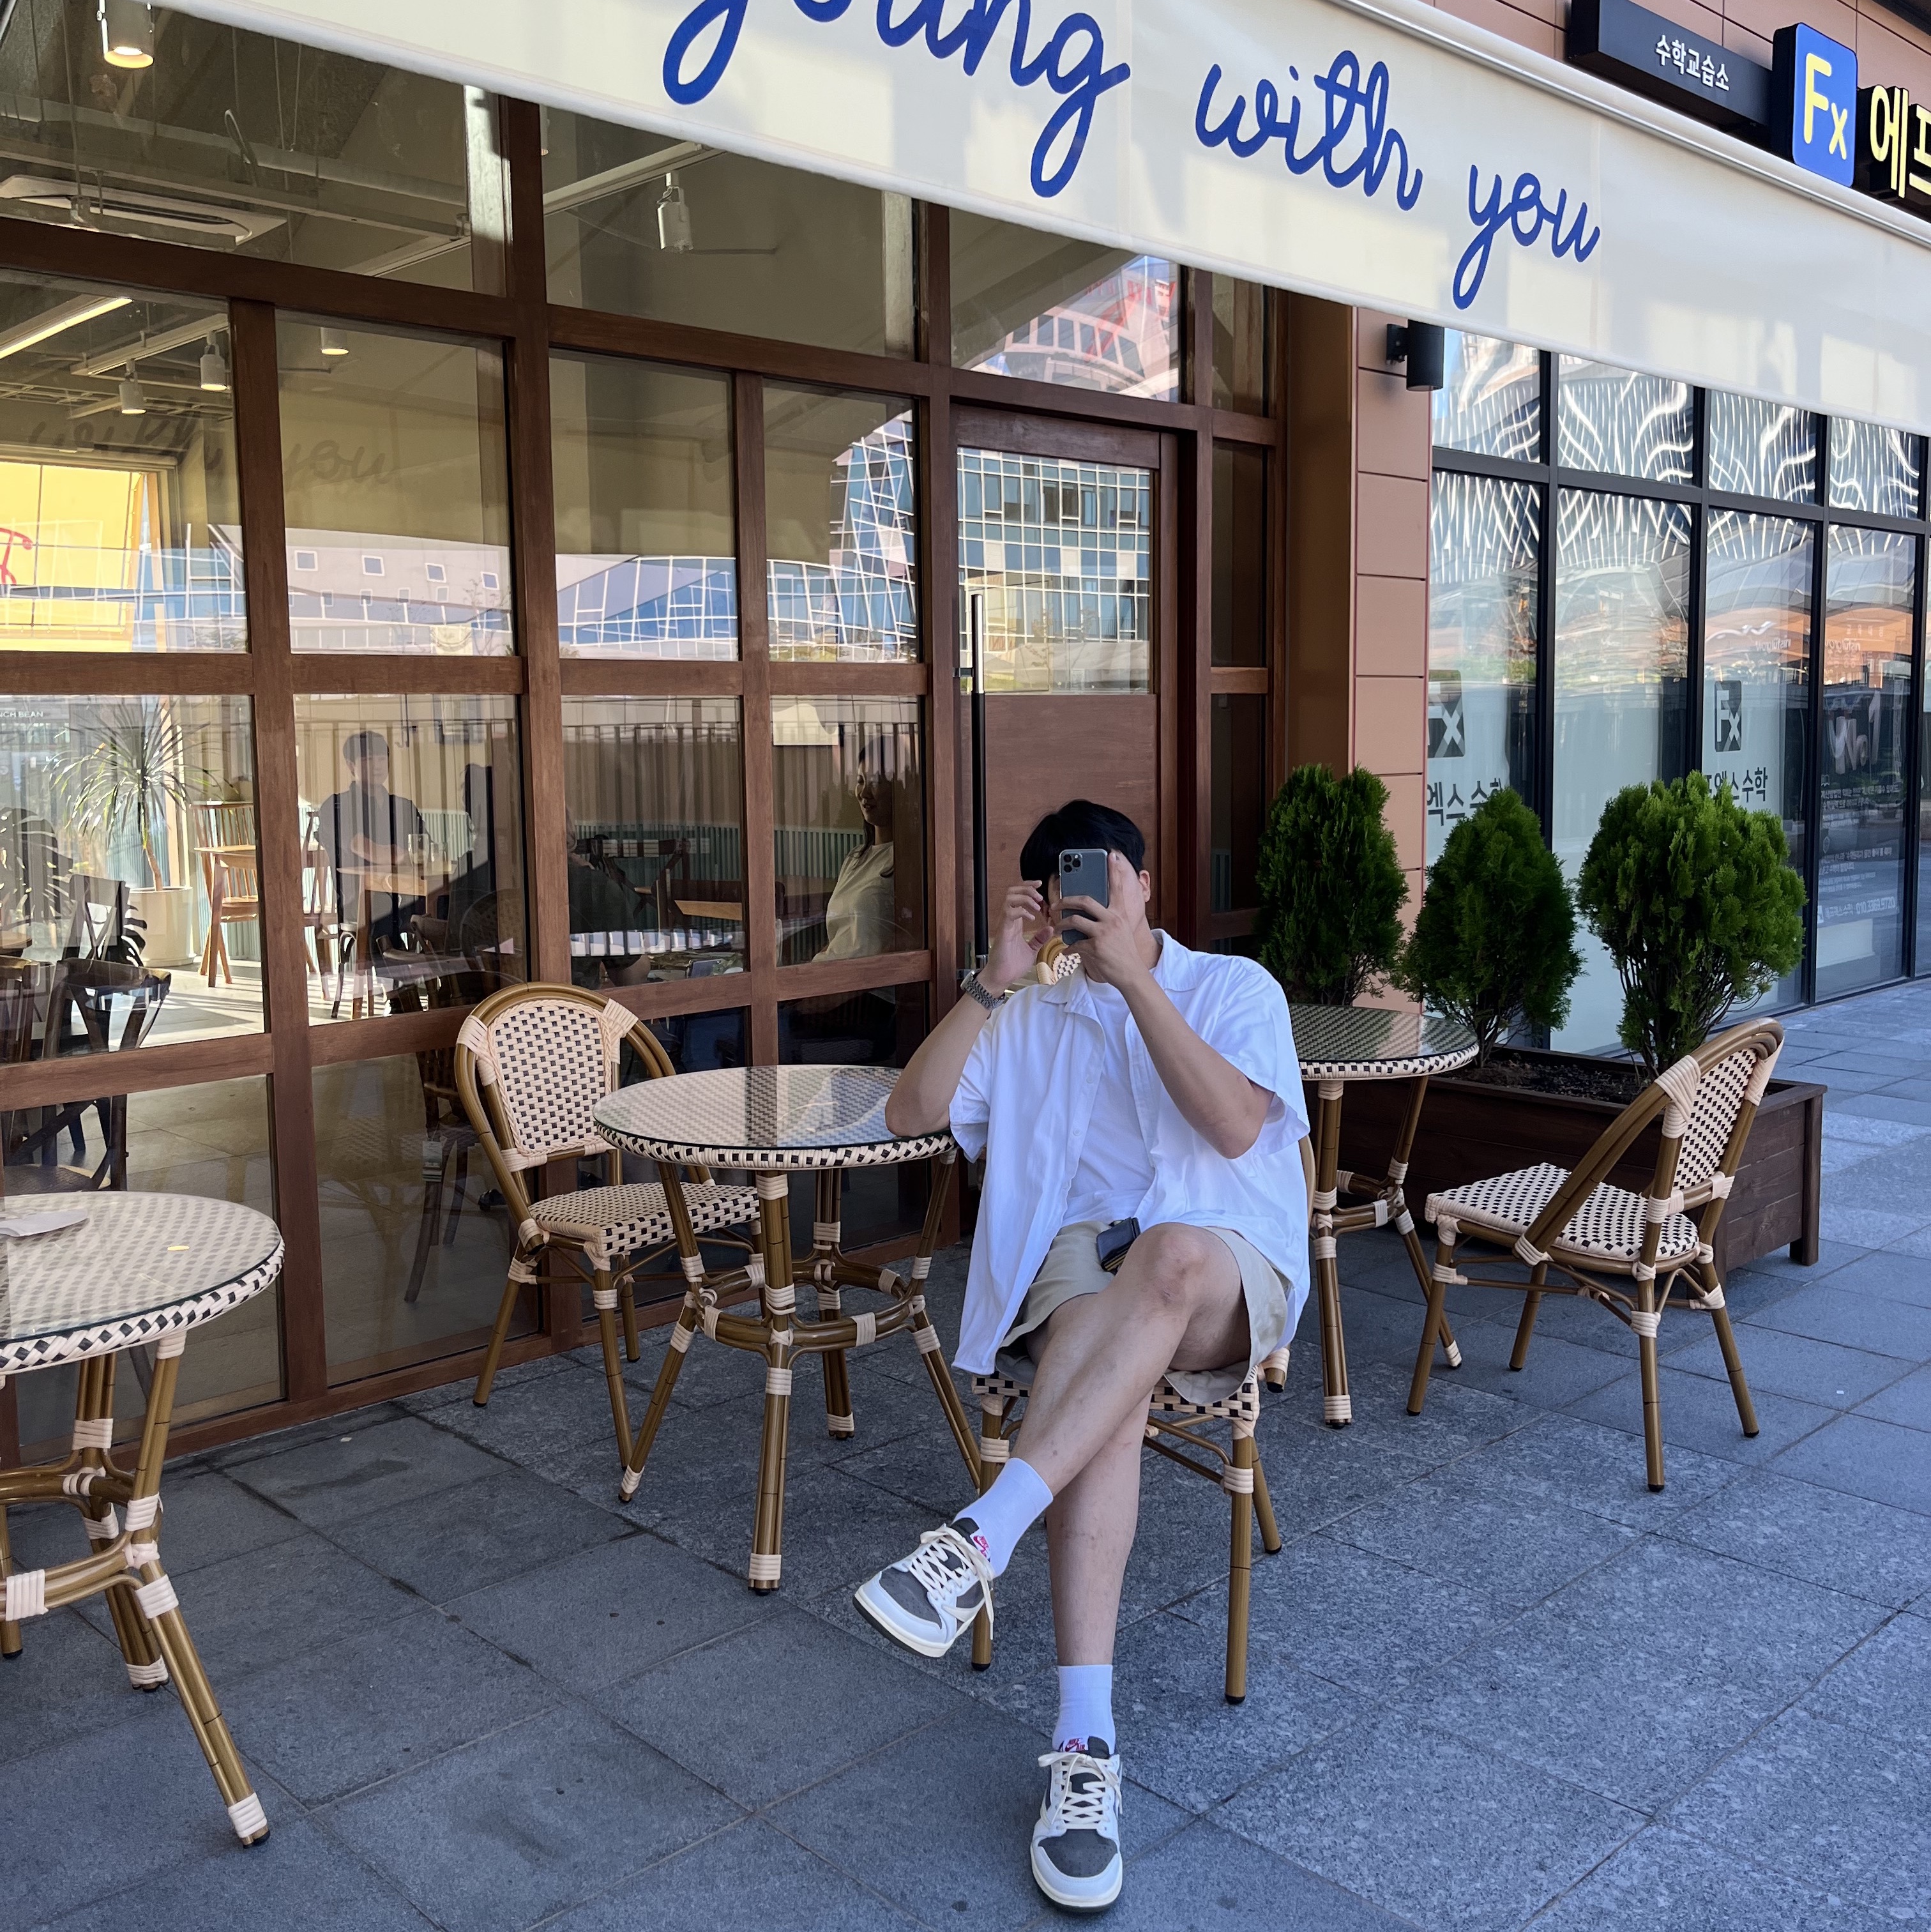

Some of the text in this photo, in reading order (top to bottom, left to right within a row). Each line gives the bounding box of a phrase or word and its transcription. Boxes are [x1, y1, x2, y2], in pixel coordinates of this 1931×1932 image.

[1655, 34, 1730, 91] 수학교습소
[1195, 50, 1423, 210] with
[1452, 164, 1600, 310] you
